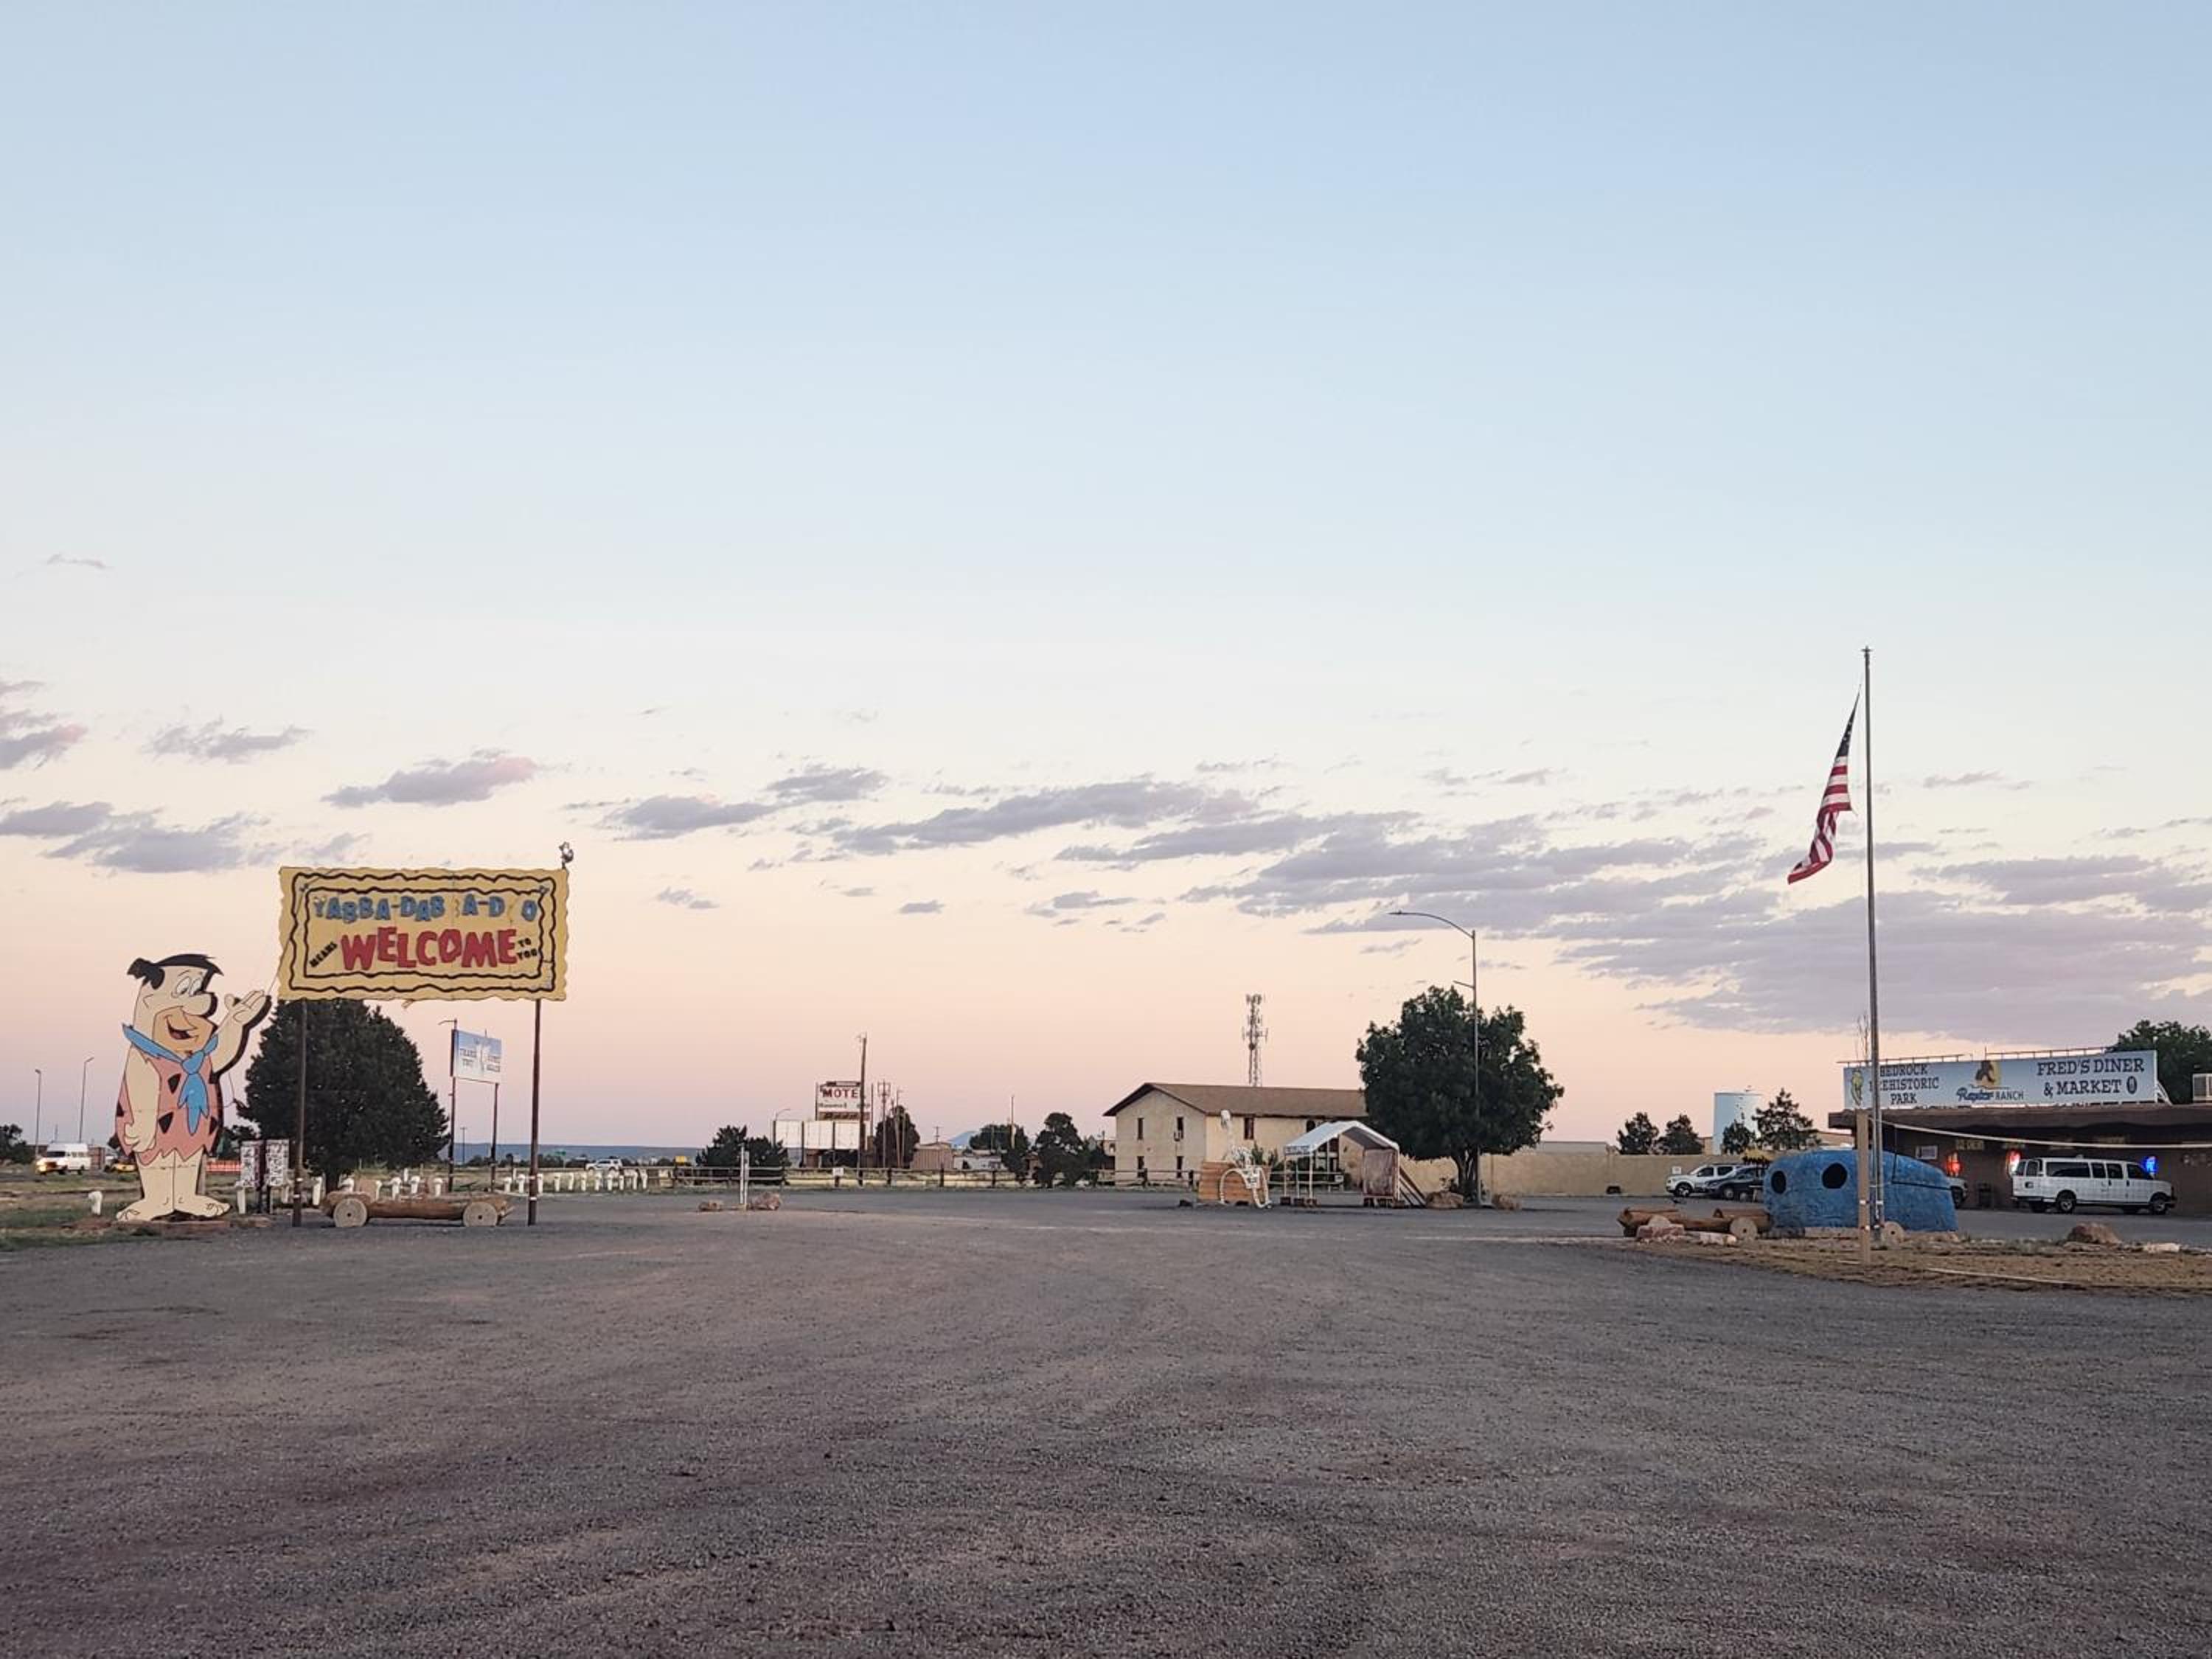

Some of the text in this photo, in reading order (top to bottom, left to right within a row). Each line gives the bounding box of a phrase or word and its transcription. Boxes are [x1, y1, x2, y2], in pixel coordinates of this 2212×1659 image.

[341, 926, 518, 971] WELCOME
[518, 937, 532, 947] TO
[517, 948, 537, 959] YOU
[1879, 1062, 1928, 1077] BEDROCK
[2037, 1058, 2144, 1075] FRED'S DINER
[1869, 1077, 1940, 1091] EHISTORIC
[2043, 1079, 2121, 1098] & MARKET
[822, 1088, 864, 1098] MOTE
[1890, 1093, 1918, 1105] PARK
[1995, 1091, 2024, 1101] RANCH
